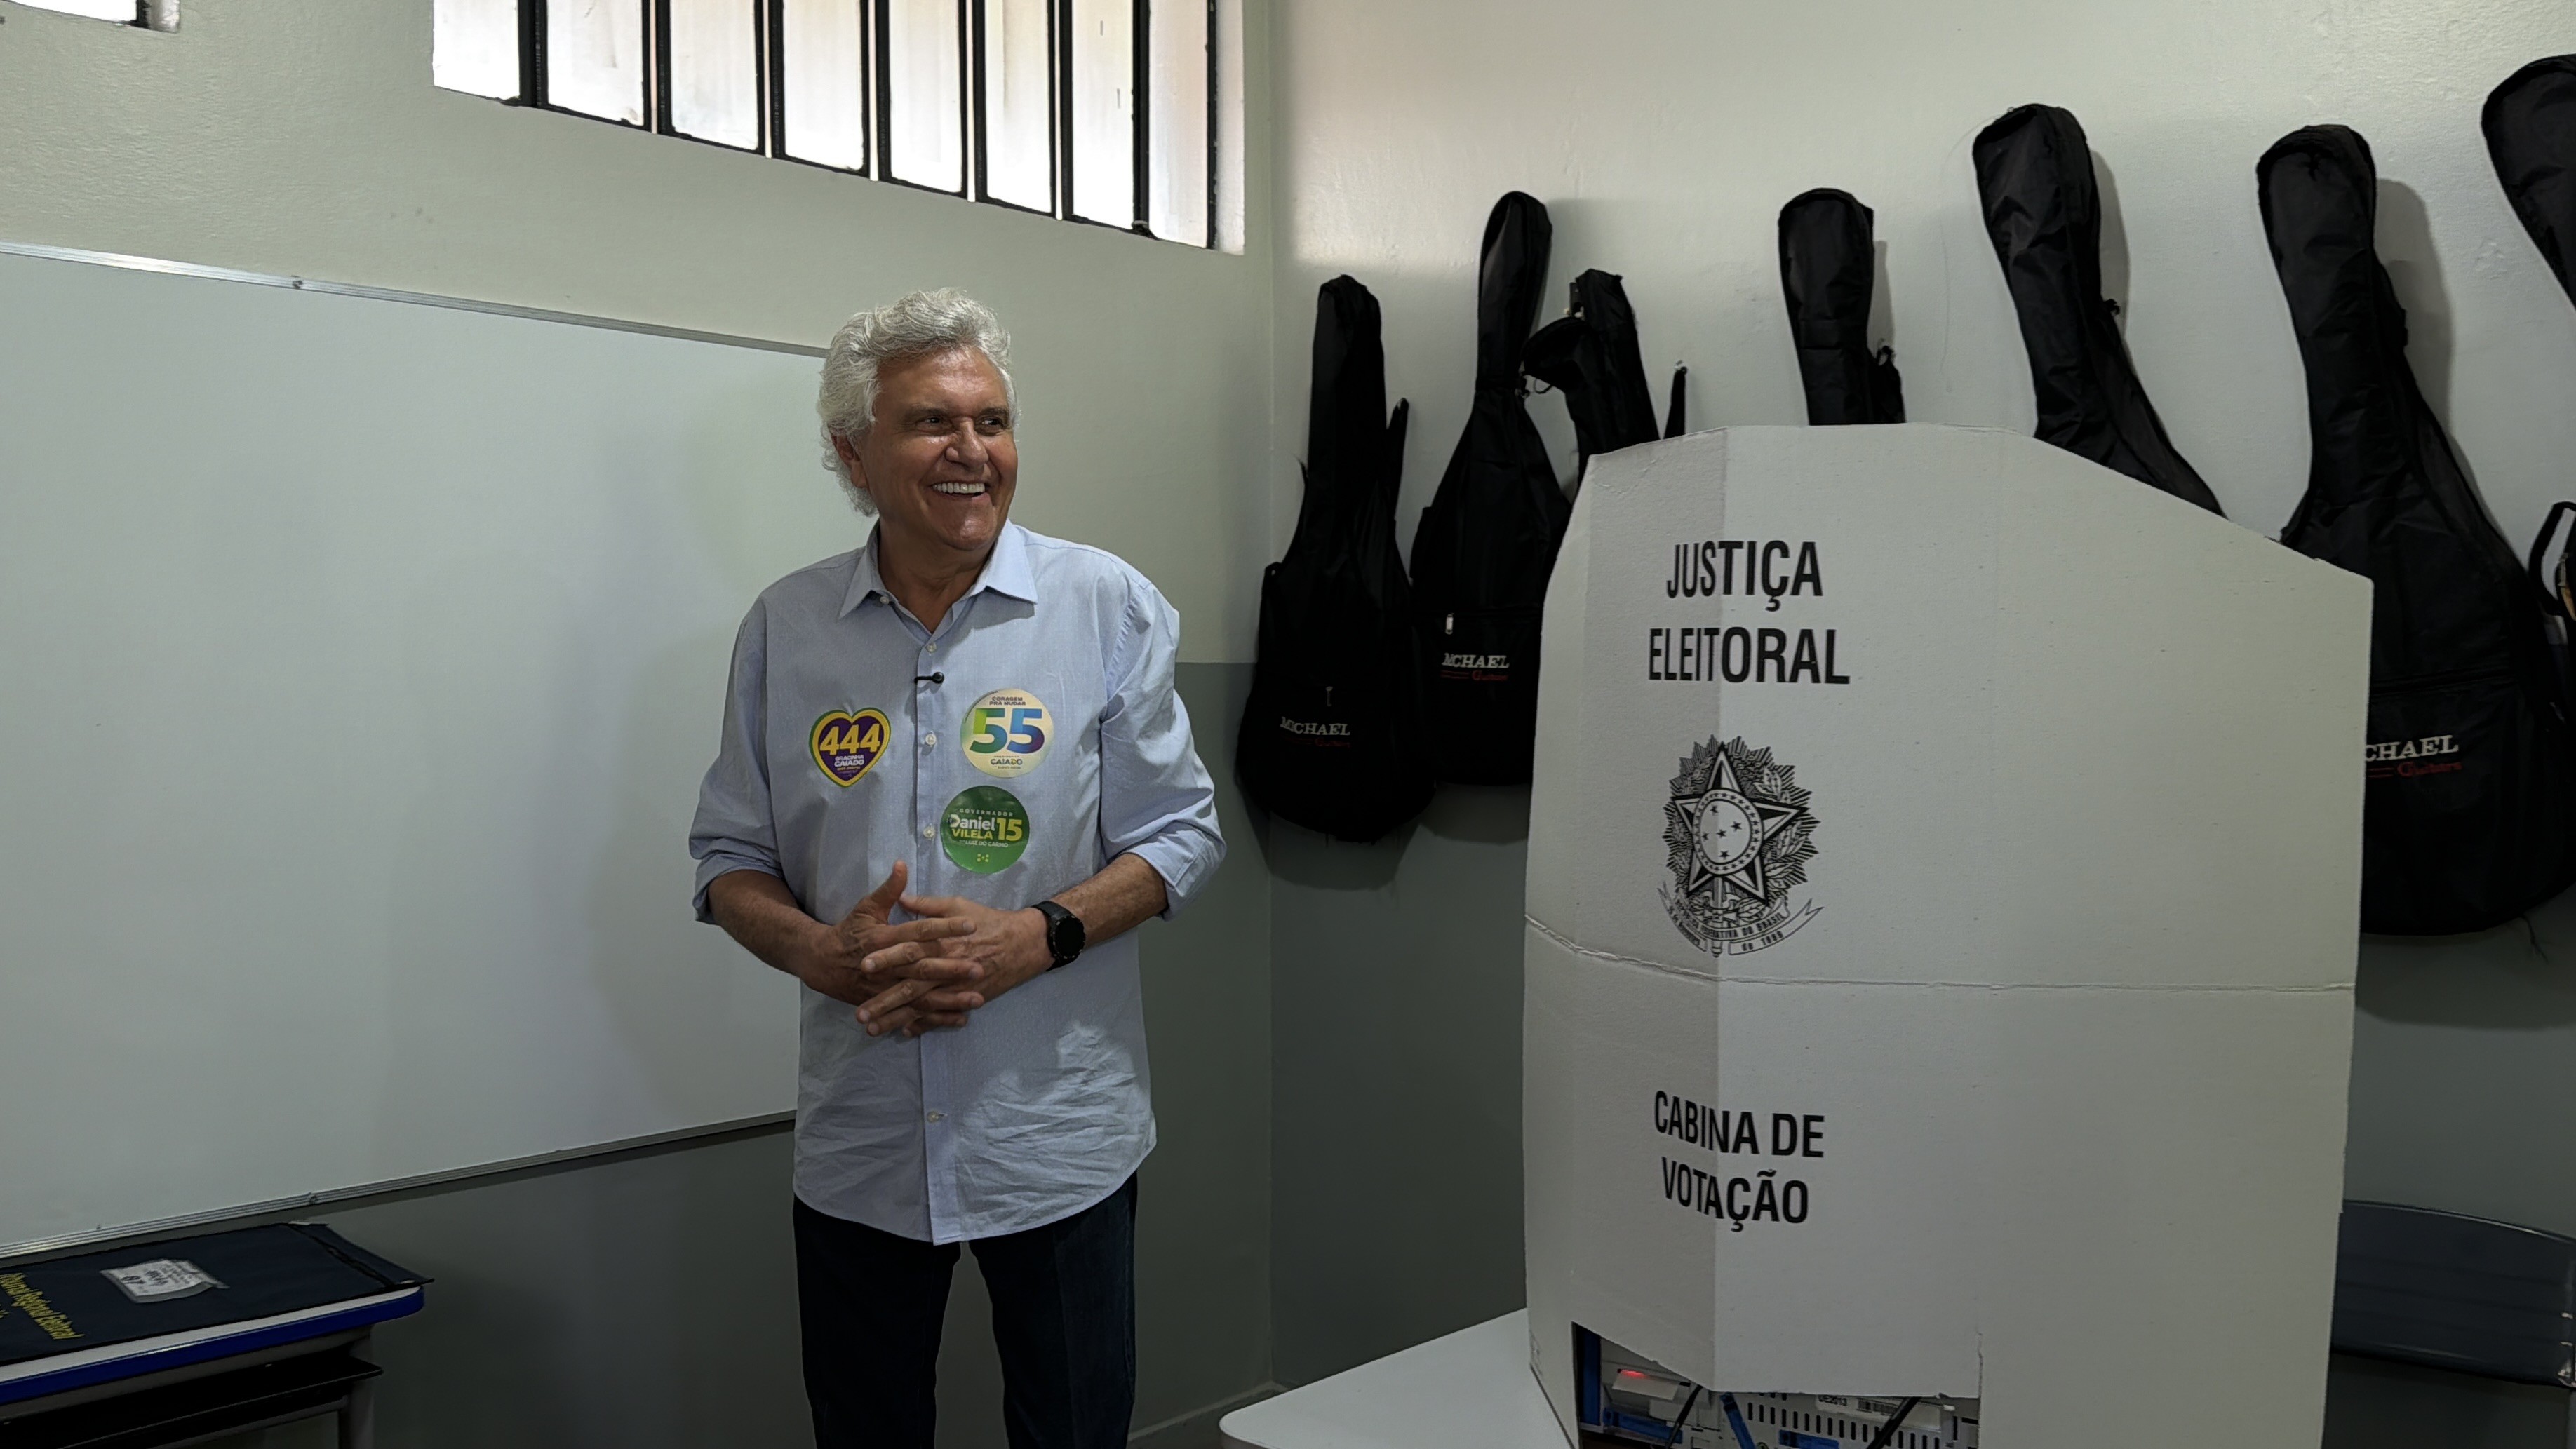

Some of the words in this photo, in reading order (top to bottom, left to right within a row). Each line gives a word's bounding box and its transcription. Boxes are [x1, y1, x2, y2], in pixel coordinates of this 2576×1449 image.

[1667, 540, 1824, 612] JUSTIÇA
[1649, 626, 1850, 685] ELEITORAL
[819, 723, 880, 755] 444
[970, 708, 1045, 754] 55
[1280, 716, 1350, 736] MICHAEL
[834, 759, 865, 767] CAIADO
[2365, 735, 2459, 762] CHAEL
[960, 808, 1013, 817] GOVERNADOR
[950, 814, 995, 831] Daniel
[996, 818, 1023, 842] 15
[952, 828, 993, 840] VILELA
[1655, 1090, 1760, 1155] CABINA
[1771, 1112, 1825, 1158] DE
[1661, 1156, 1809, 1233] VOTAÇÃO
